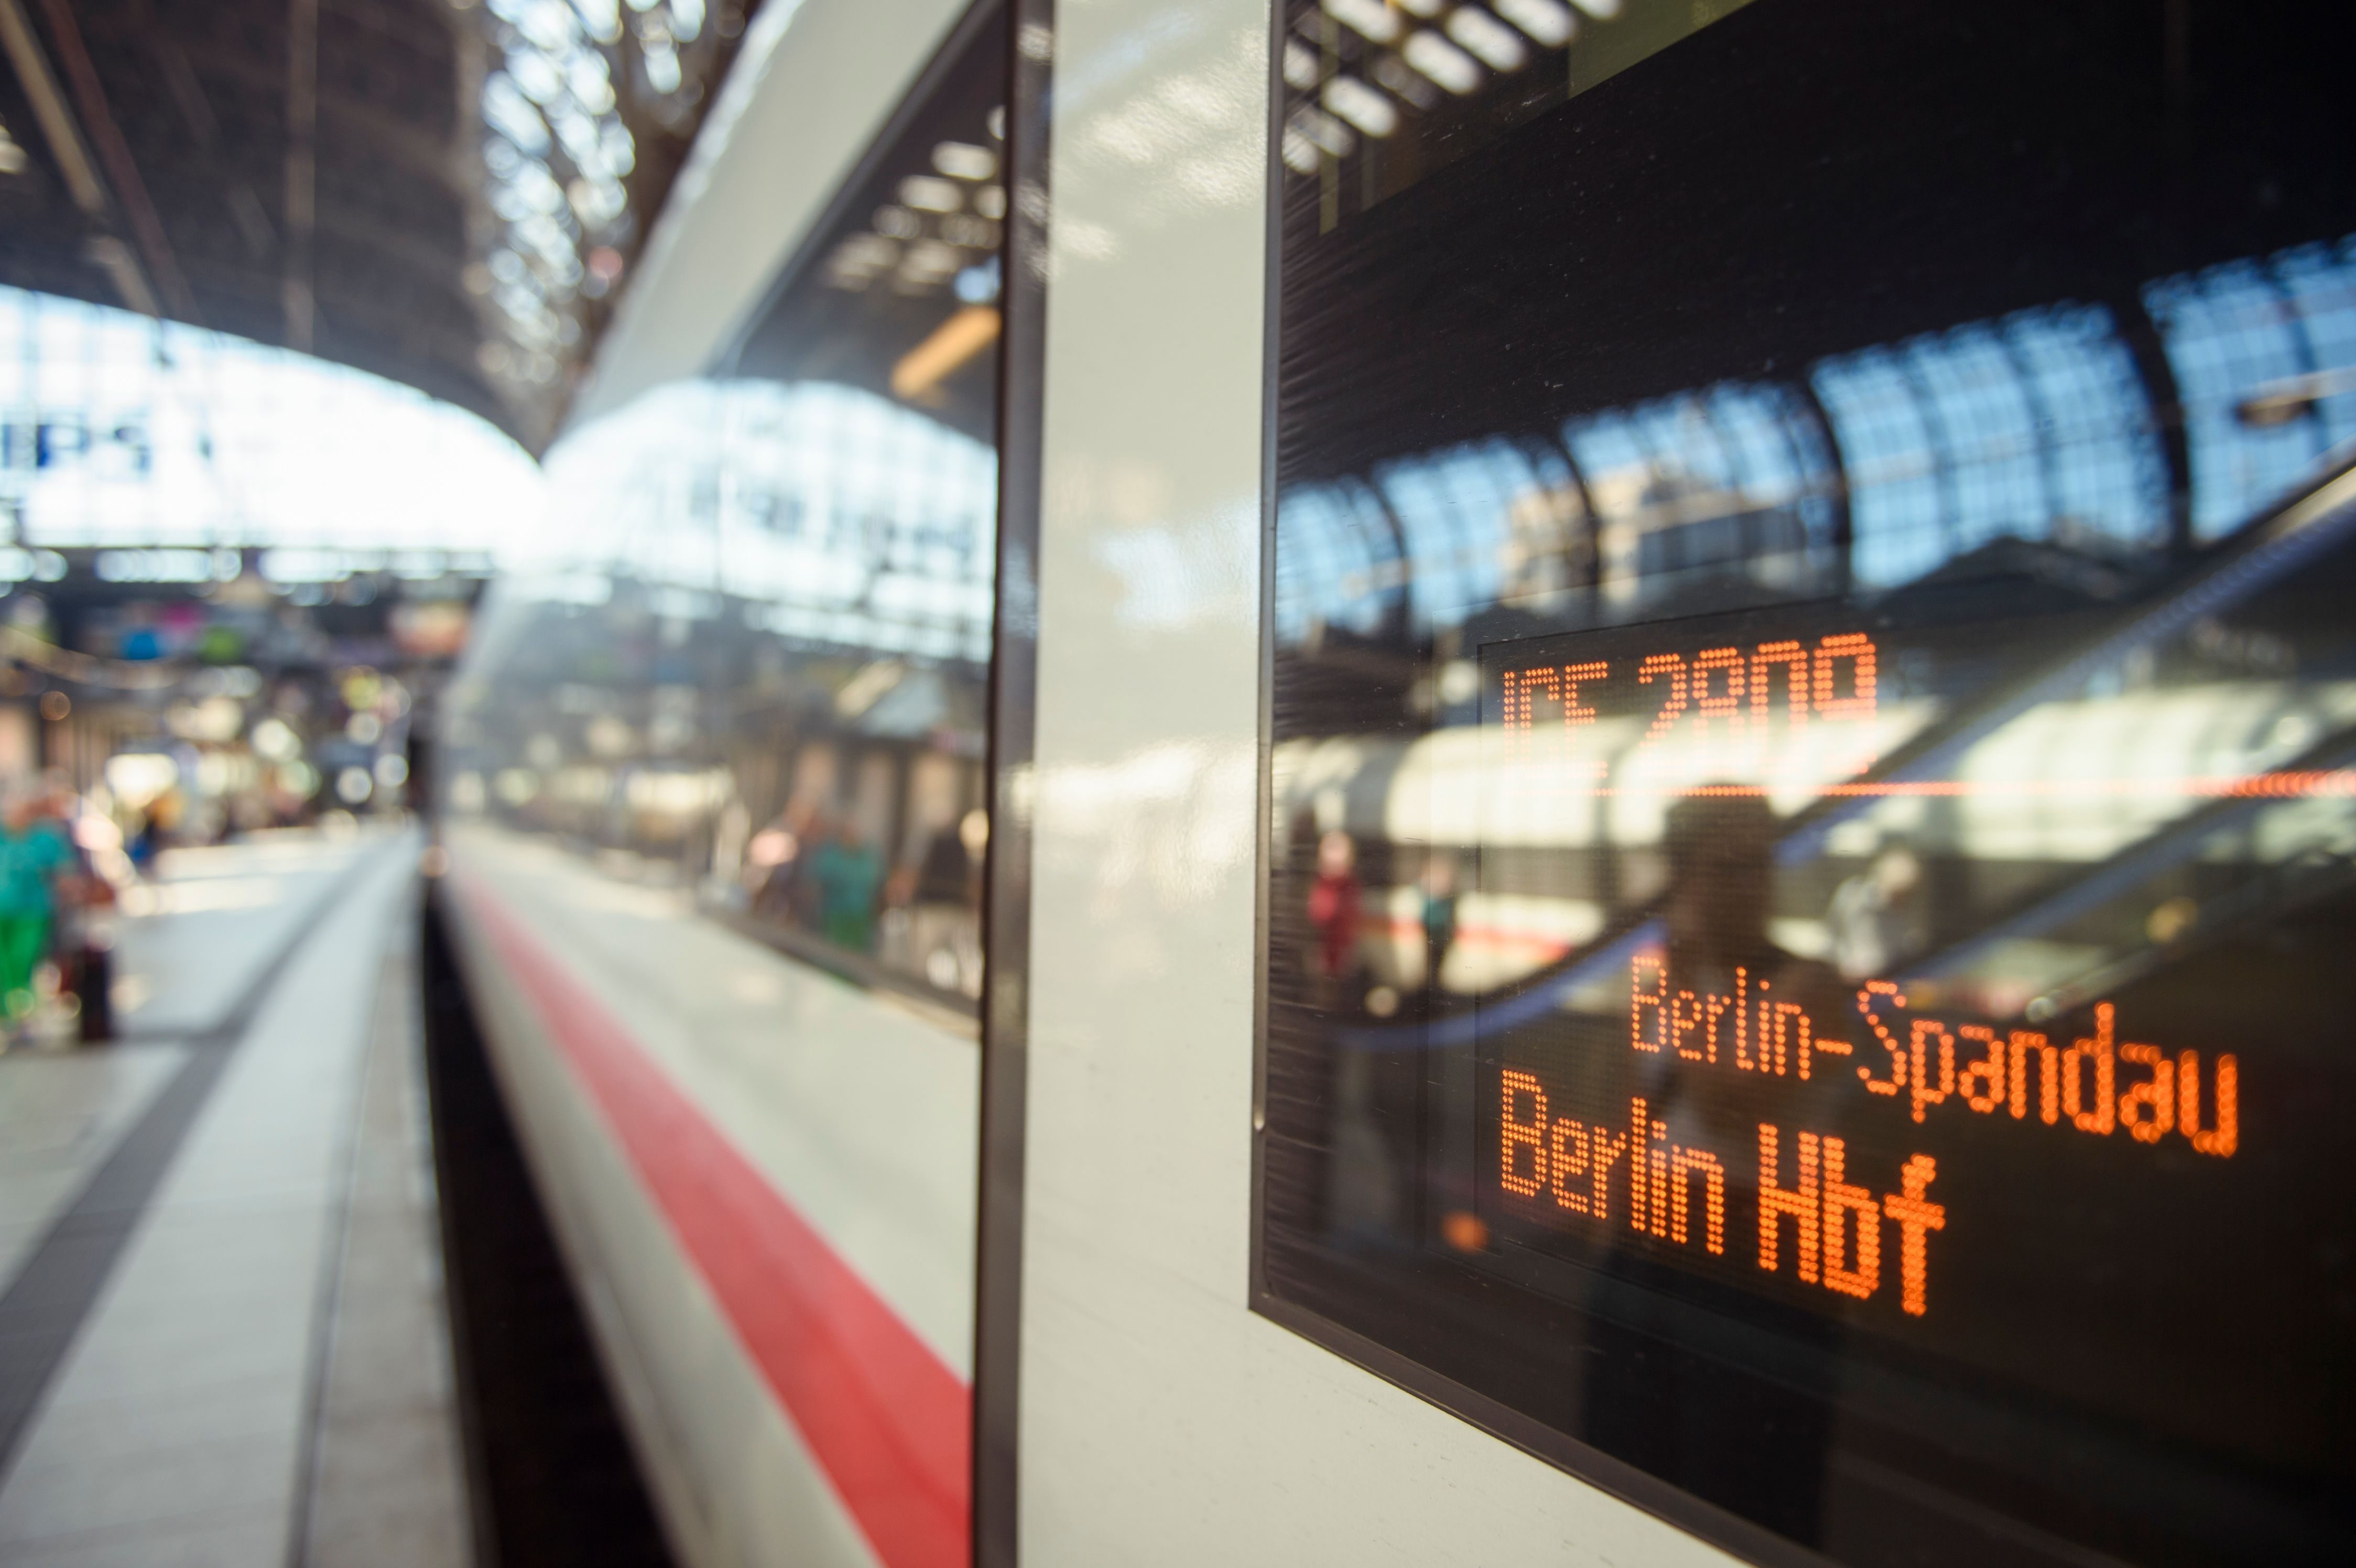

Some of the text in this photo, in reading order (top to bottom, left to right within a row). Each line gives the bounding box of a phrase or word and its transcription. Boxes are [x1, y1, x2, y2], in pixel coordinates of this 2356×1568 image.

[1503, 631, 1878, 778] ICE 2809
[1631, 956, 2238, 1157] Berlin-Spandau
[1501, 1069, 1946, 1316] Berlin Hbf
